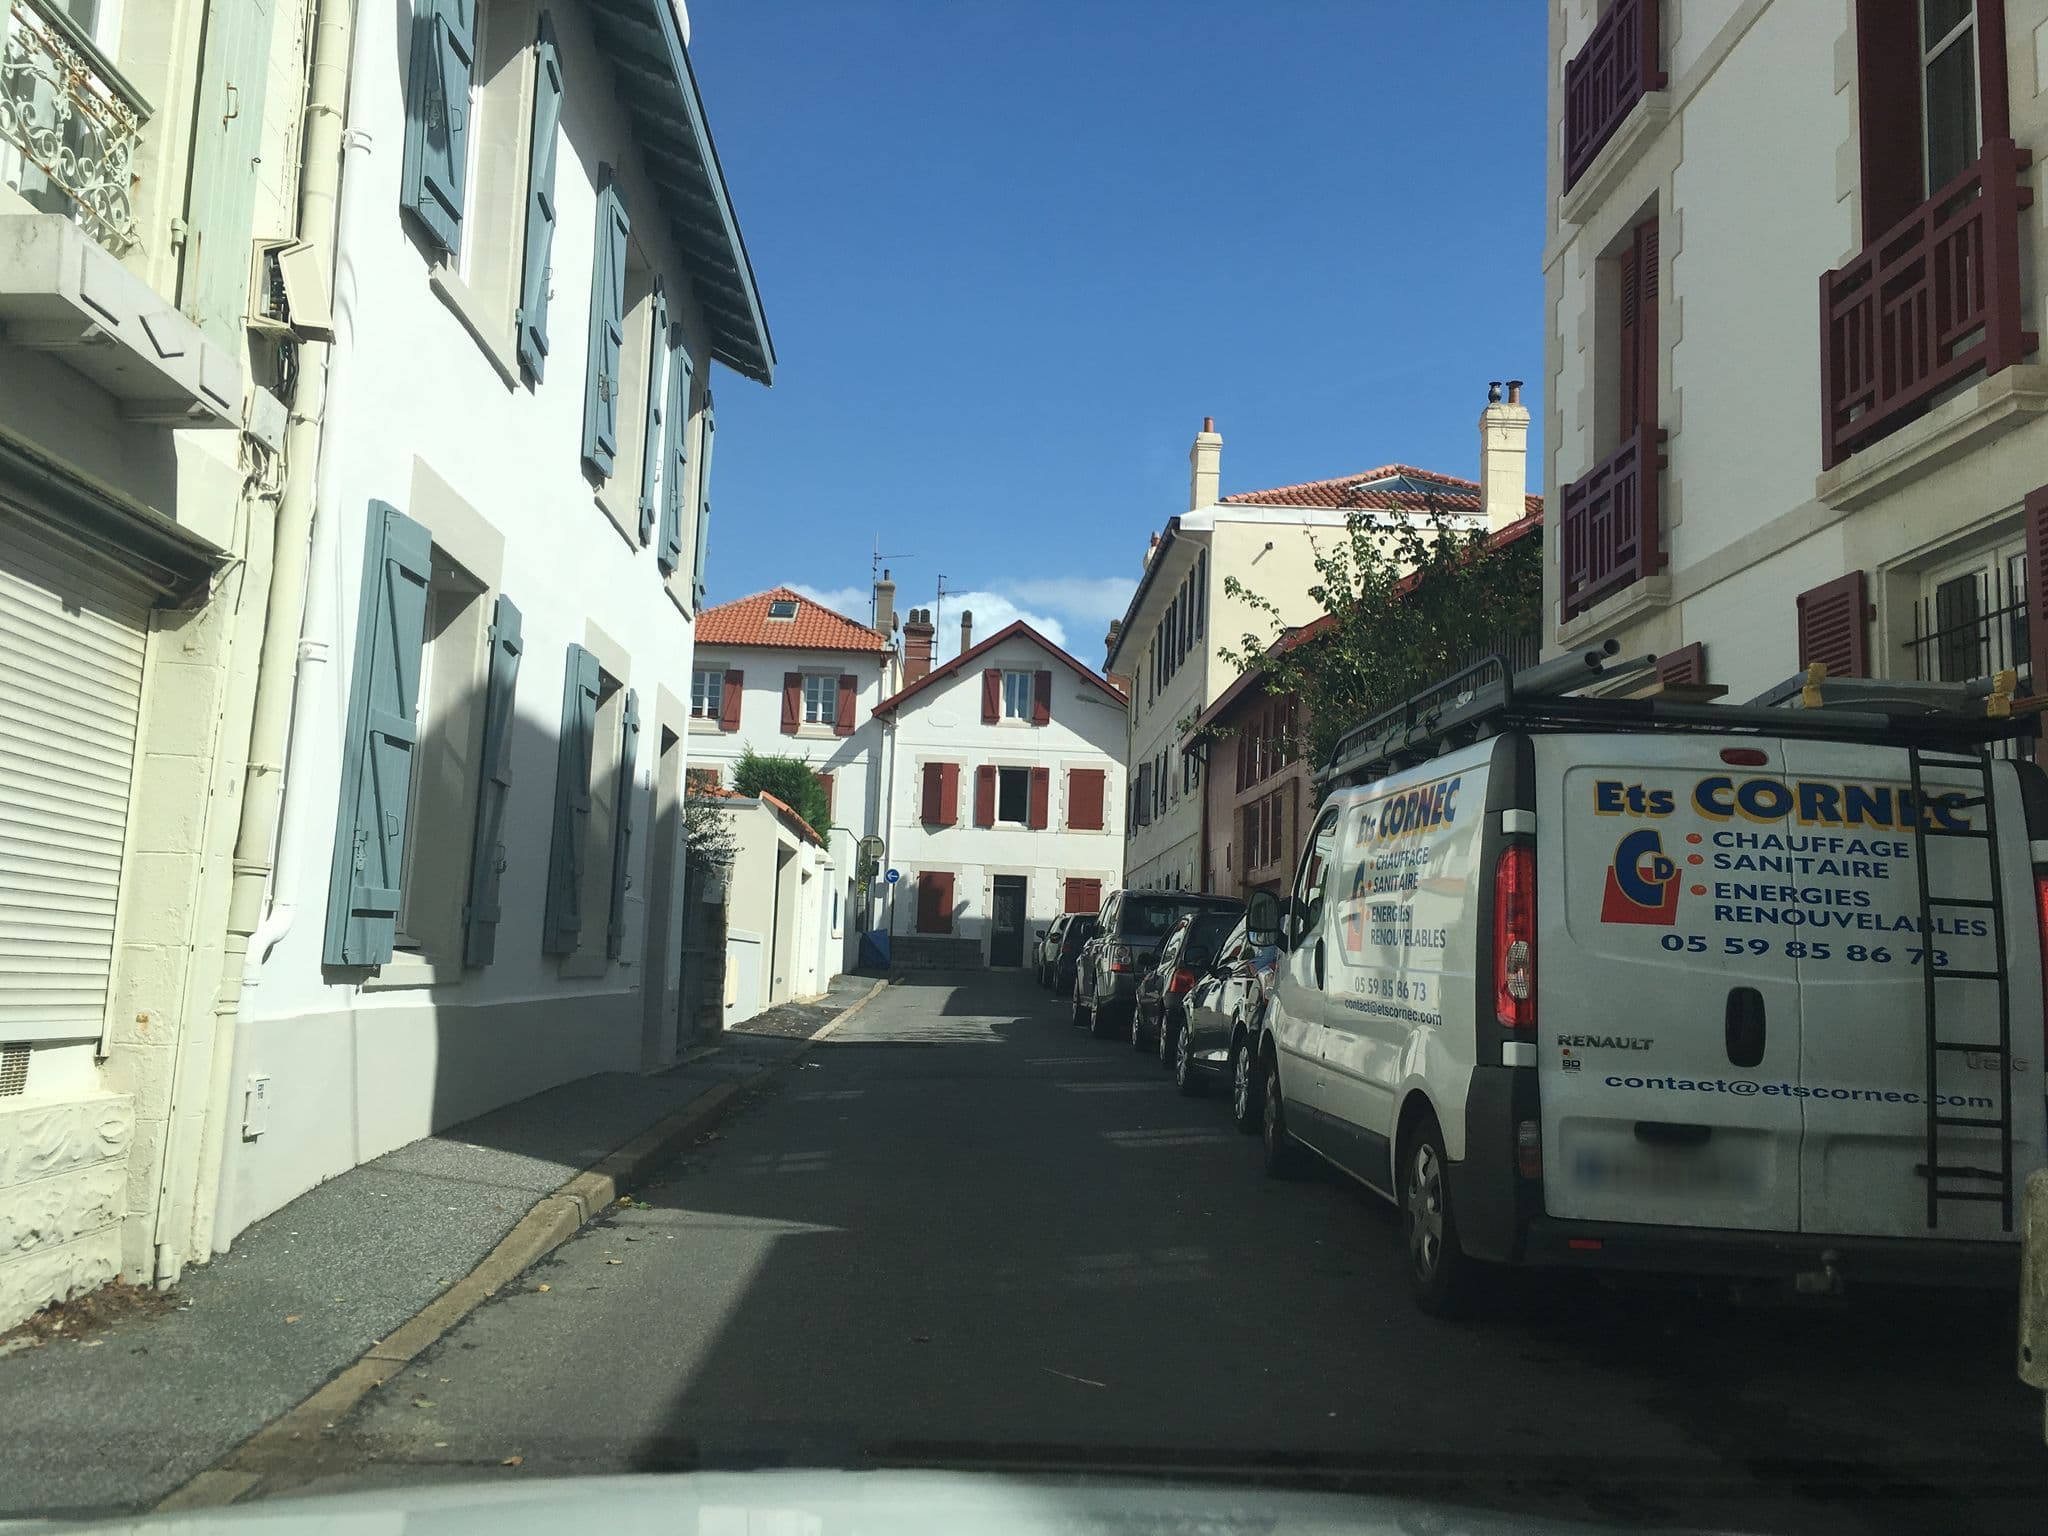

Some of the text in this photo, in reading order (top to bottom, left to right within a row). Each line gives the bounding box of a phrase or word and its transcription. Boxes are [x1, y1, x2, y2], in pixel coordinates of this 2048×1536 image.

[1377, 777, 1461, 843] CORNEC
[1593, 772, 1970, 833] Ets CORNEC
[1712, 831, 1909, 859] CHAUFFAGE
[1376, 847, 1429, 871] CHAUFFAGE
[1714, 853, 1890, 880] SANITAIRE
[1373, 872, 1419, 893] SANITAIRE
[1714, 882, 1872, 908] ENERGIES
[1371, 904, 1410, 923] ENERGIES
[1370, 928, 1447, 949] RENOUVELABLES
[1661, 934, 1949, 967] 05 59 85 86 73
[1354, 976, 1426, 1002] 05 59 85 86 73
[1344, 998, 1442, 1026] contact@etscornec.com
[1557, 1032, 1655, 1051] RENAULT
[1604, 1075, 1994, 1109] contact@etscornec.com
